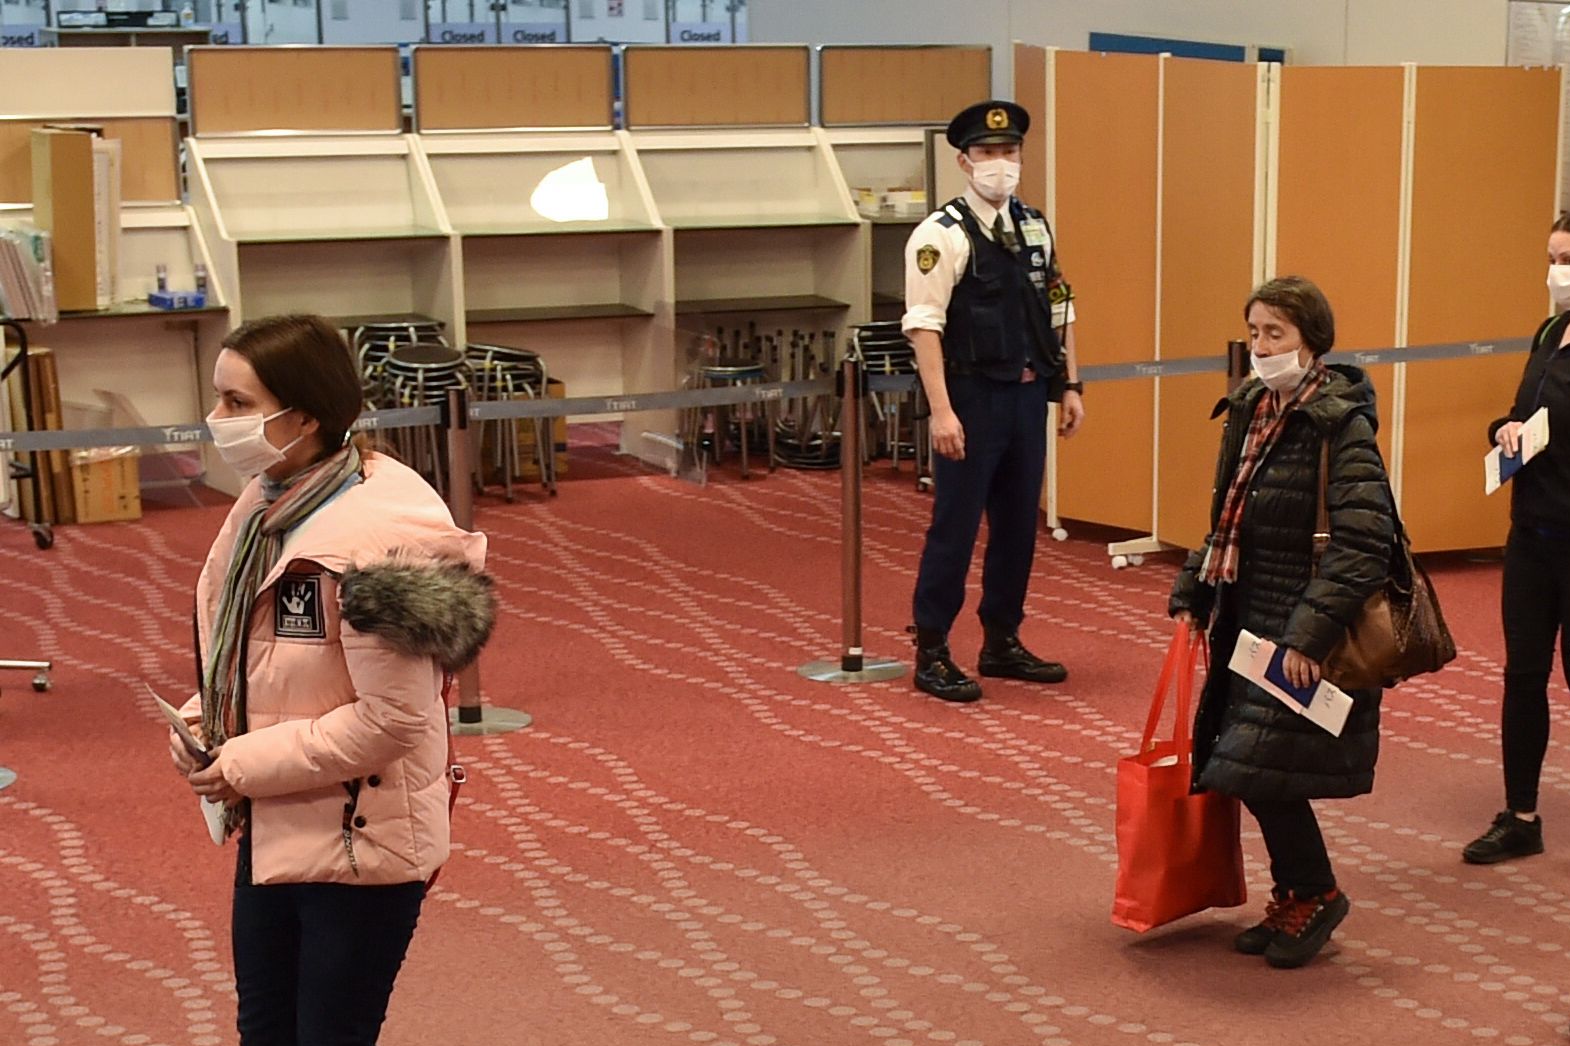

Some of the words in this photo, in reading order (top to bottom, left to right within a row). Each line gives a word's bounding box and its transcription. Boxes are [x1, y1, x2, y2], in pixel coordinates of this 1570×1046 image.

[441, 30, 485, 43] Closed
[513, 30, 556, 43] Closed
[680, 29, 721, 42] Closed
